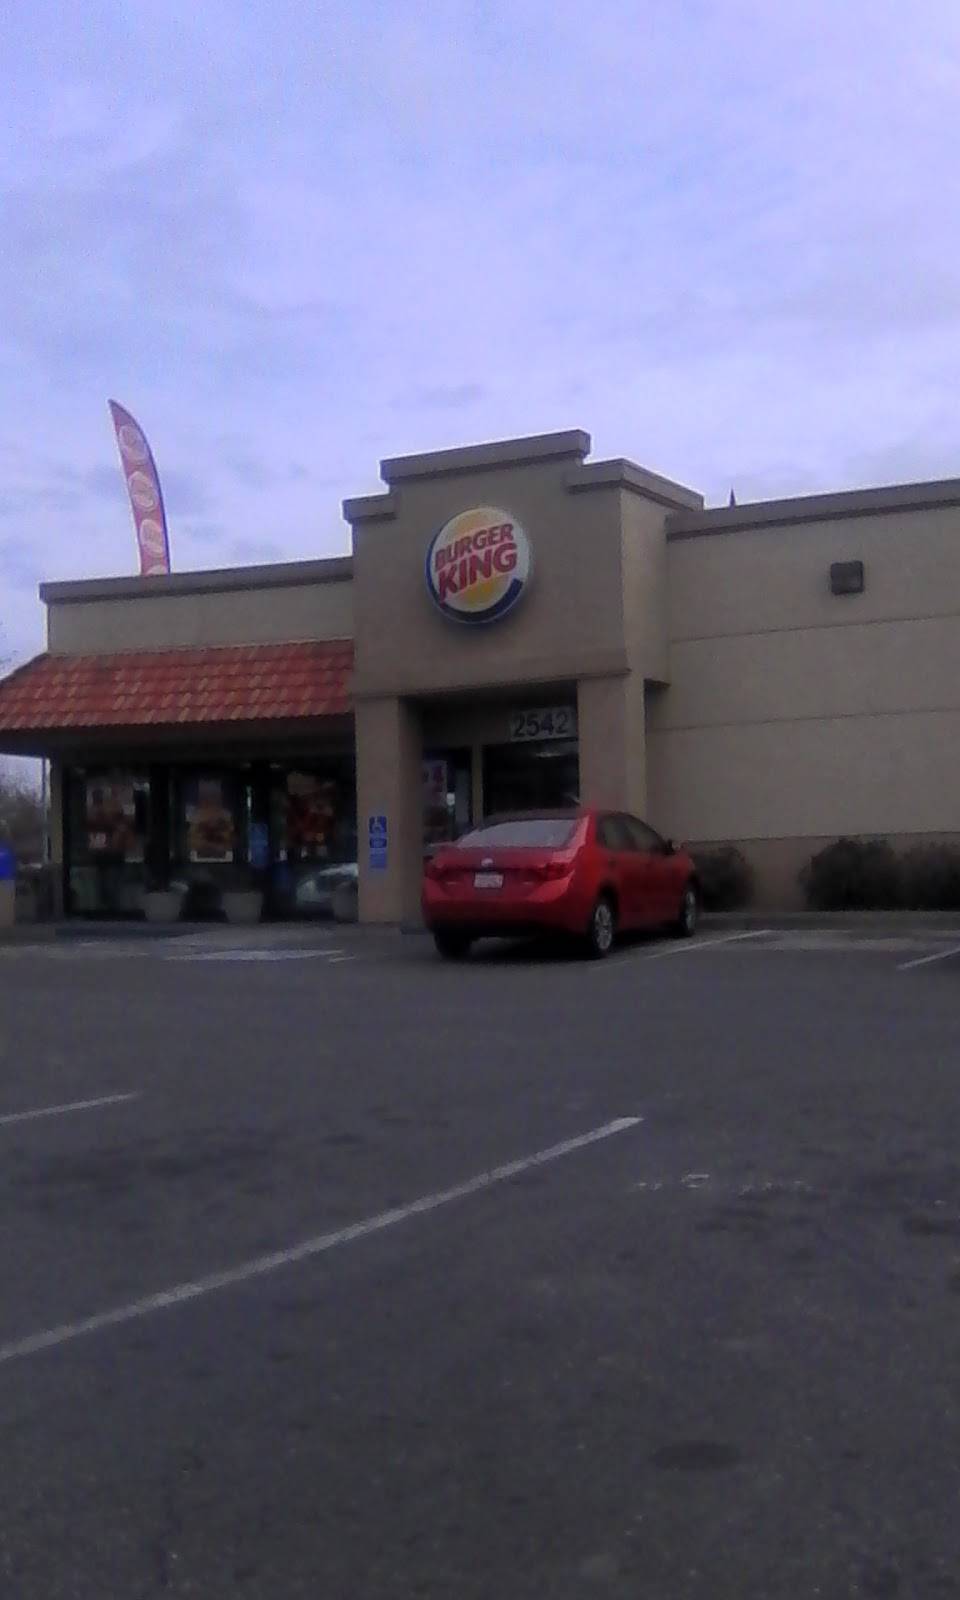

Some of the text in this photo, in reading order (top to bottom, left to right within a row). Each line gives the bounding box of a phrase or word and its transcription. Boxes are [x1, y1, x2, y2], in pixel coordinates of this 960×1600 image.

[435, 523, 514, 571] BURGER
[438, 542, 518, 608] KING
[513, 712, 569, 737] 2542
